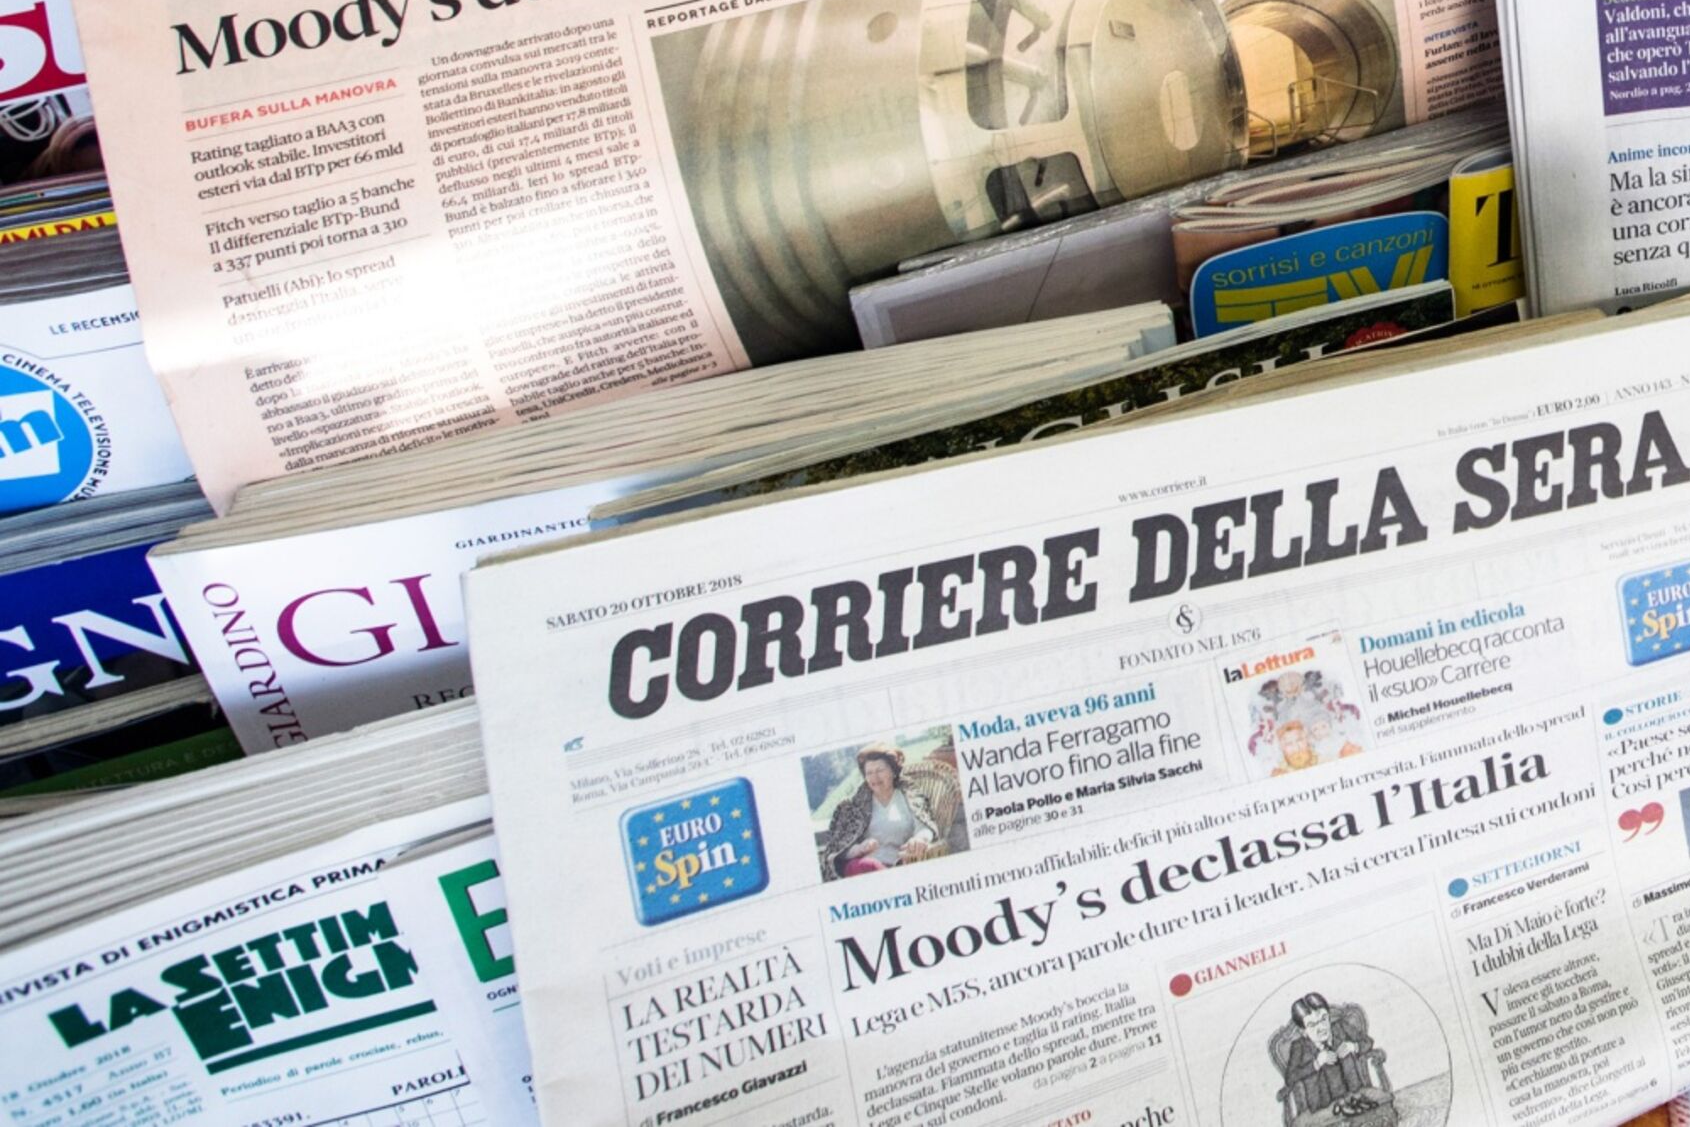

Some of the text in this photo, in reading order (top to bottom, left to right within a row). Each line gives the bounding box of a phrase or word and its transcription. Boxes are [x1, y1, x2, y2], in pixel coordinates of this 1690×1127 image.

[1608, 63, 1679, 83] salvando
[185, 77, 396, 132] BUFERA SULLA MANOVRA
[1607, 146, 1654, 164] Anime
[2, 353, 111, 477] CINEMA TELEVISIONE
[546, 574, 742, 629] SABATO OTTOBRE 2018
[608, 527, 1100, 720] CORRIERE
[1129, 467, 1428, 603] DELLA
[1119, 641, 1192, 670] FONDATO
[1361, 624, 1433, 654] Domani
[1364, 632, 1482, 678] Houellebecq
[961, 712, 1171, 771] Wanda Ferragamo
[994, 730, 1201, 793] lavoro fine
[660, 812, 721, 847] EURO
[653, 841, 736, 889] Spin
[1119, 812, 1364, 906] declassa
[1473, 841, 1582, 887] SETTEGIORNI
[138, 883, 304, 950] ENIGMISTICA
[675, 946, 803, 1013] REALTÀ
[1194, 941, 1287, 985] GIANNELLI
[627, 985, 806, 1063] TESTARDA
[701, 1013, 828, 1079] NUMERI
[741, 1060, 807, 1094] Giavazzi
